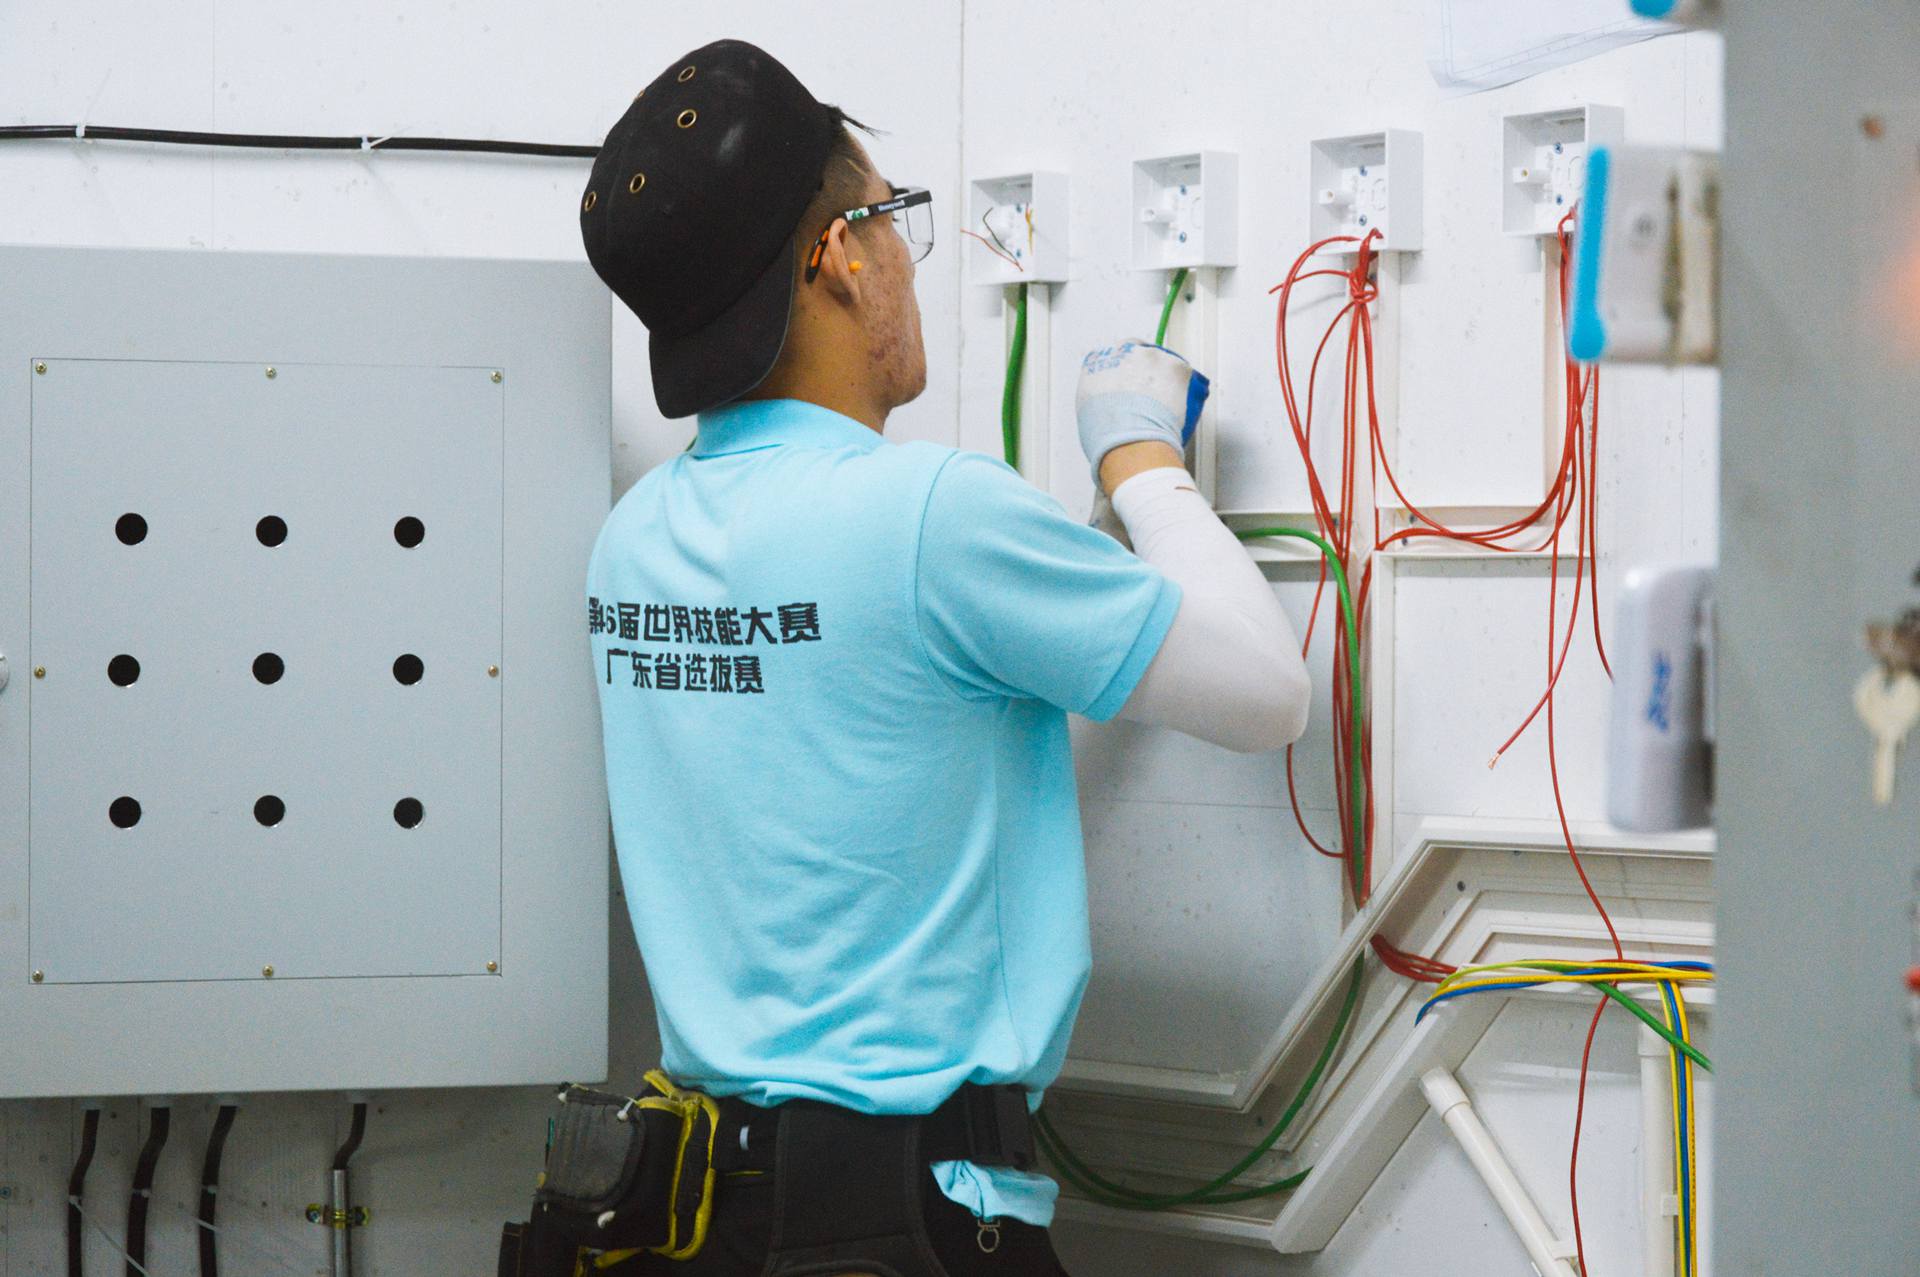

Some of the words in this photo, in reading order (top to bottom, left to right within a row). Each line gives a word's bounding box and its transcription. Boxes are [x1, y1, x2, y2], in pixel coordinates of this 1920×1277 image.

[607, 648, 765, 694] 广东省选拔赛
